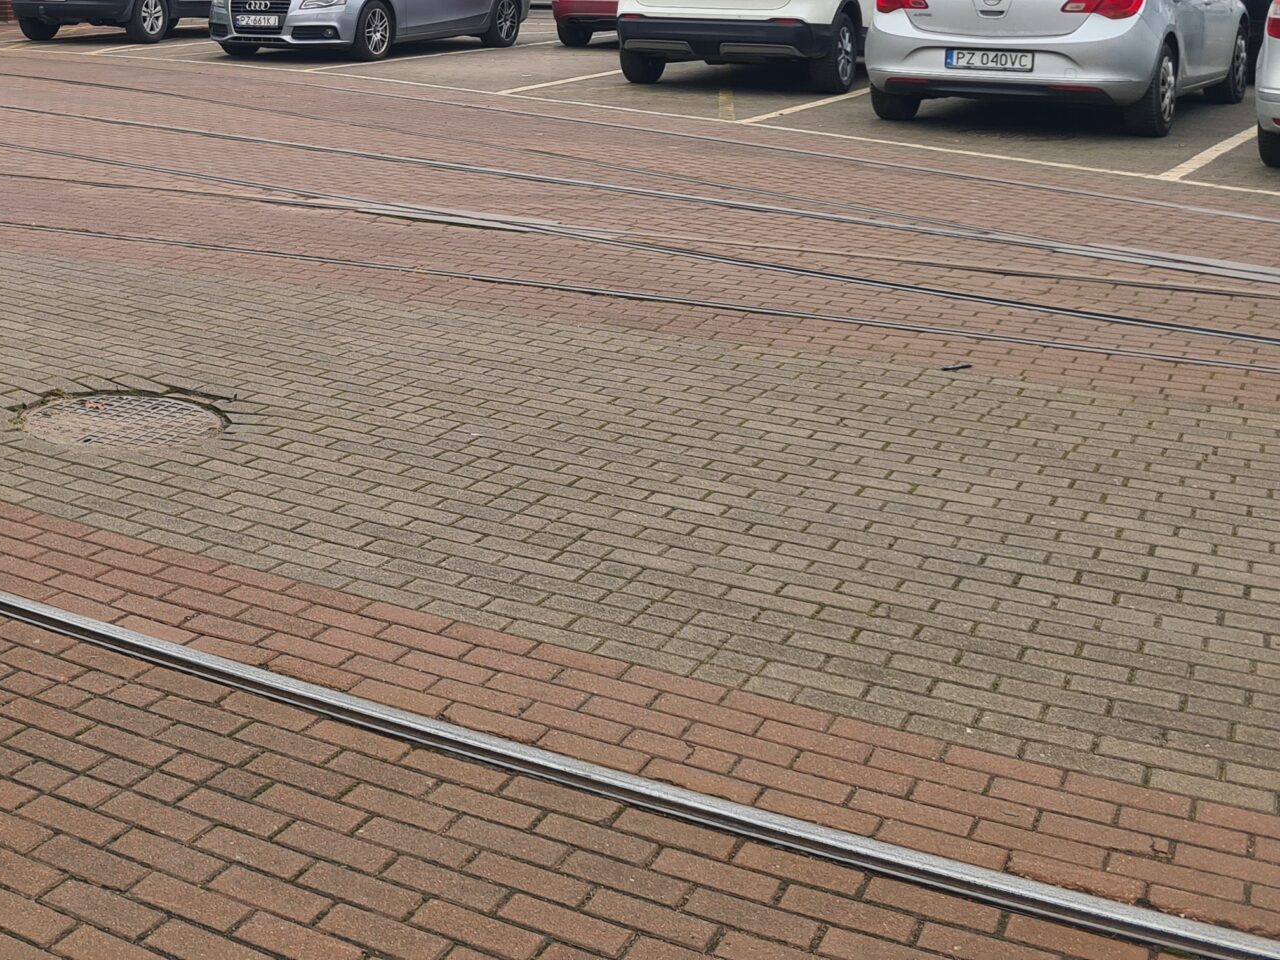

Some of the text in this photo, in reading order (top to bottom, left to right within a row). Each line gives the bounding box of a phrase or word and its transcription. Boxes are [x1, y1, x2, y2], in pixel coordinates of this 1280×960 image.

[240, 16, 251, 24] PZ
[956, 51, 1028, 68] PZ 040VC
